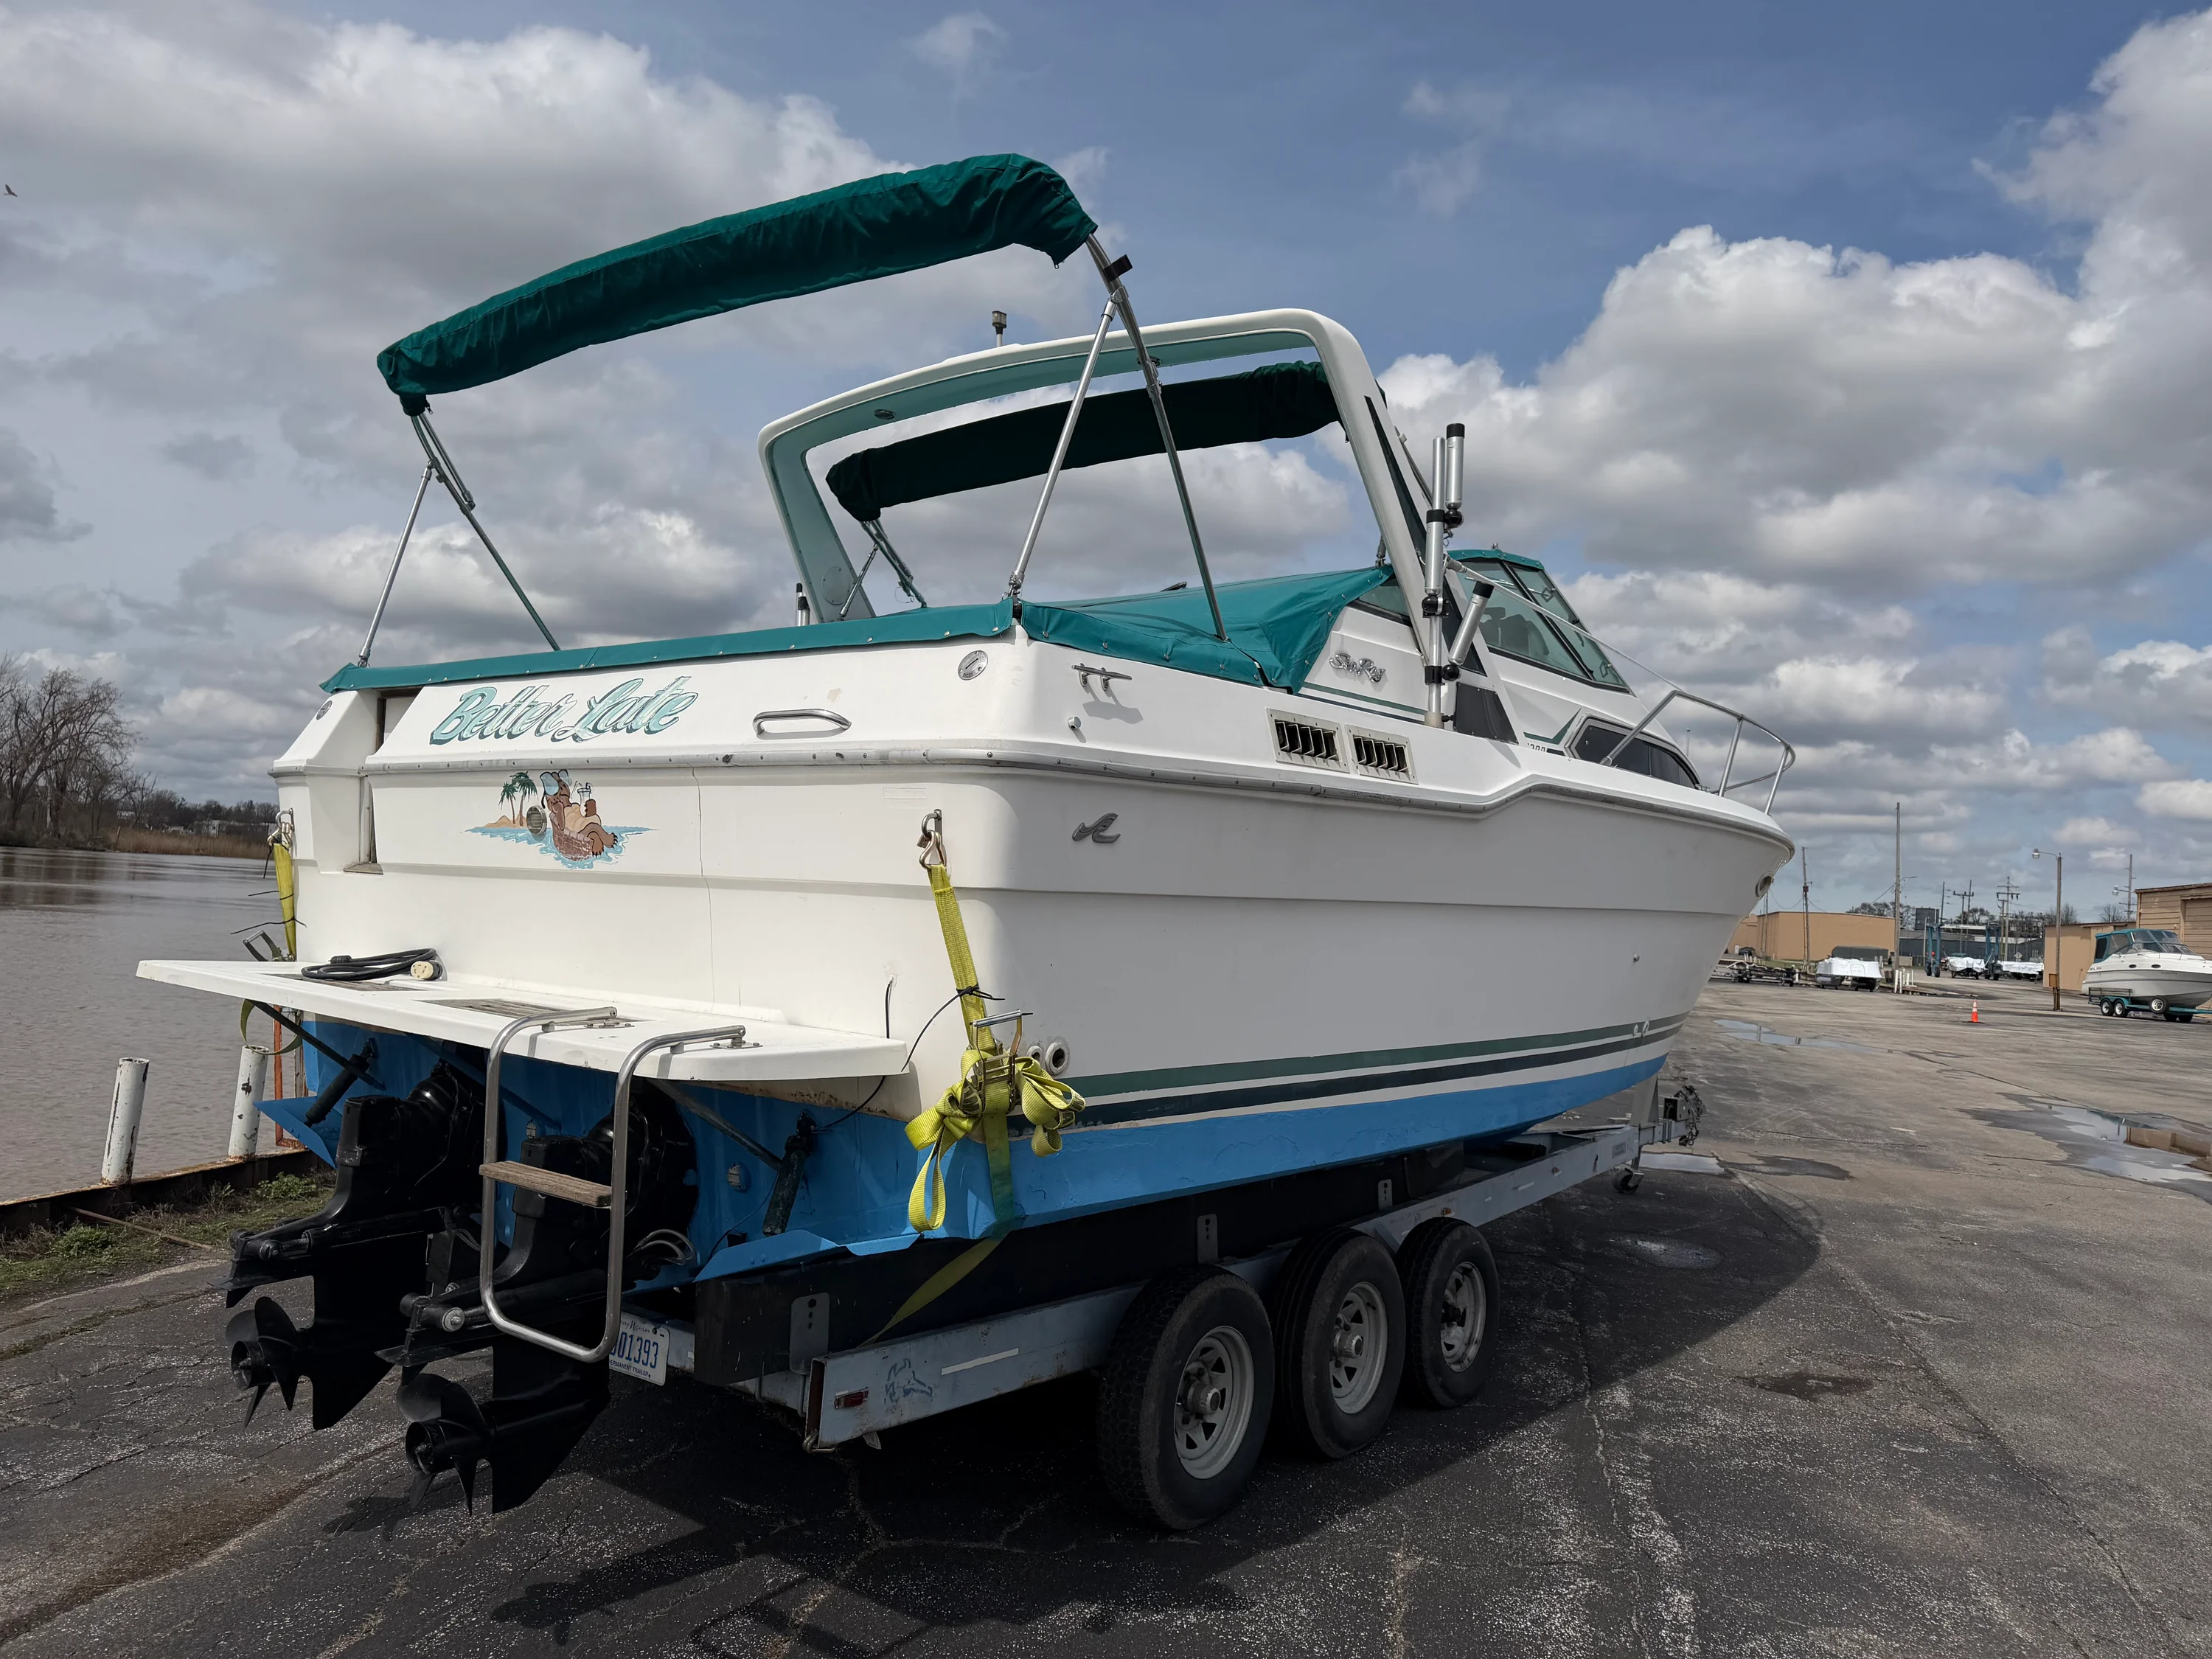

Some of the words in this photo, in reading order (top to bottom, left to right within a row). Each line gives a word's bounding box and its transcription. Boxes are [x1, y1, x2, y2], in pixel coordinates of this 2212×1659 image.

[1329, 653, 1357, 672] Sea
[1358, 658, 1386, 682] Ray
[430, 684, 578, 745] Better
[551, 676, 698, 743] Late
[633, 1367, 649, 1377] TRAILER
